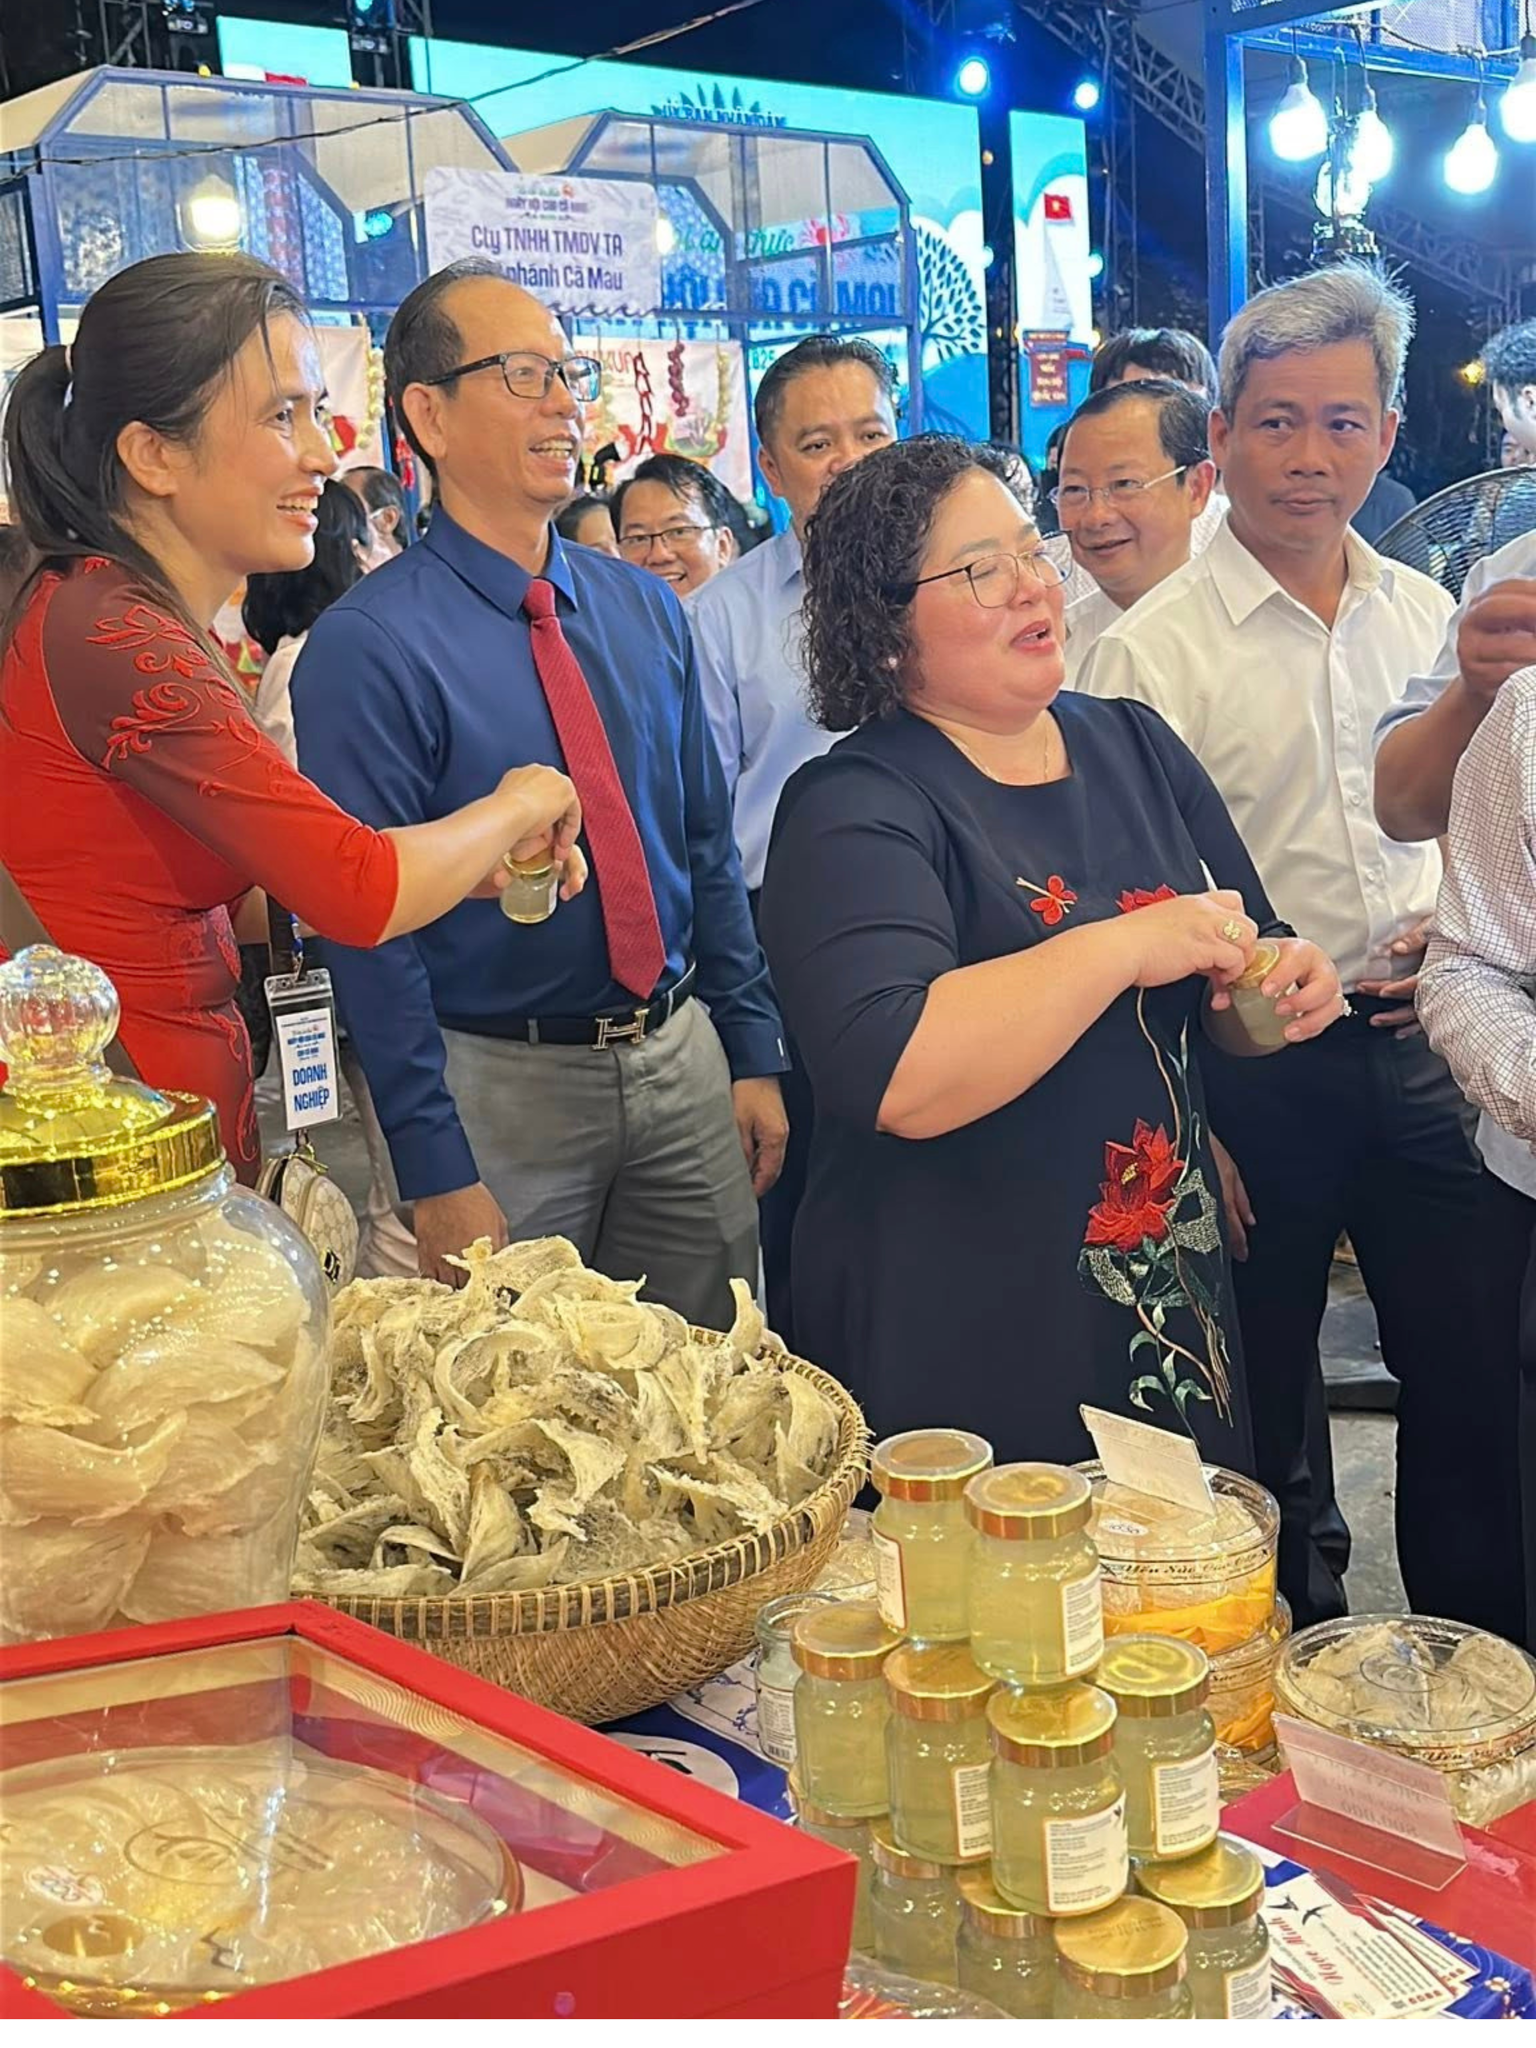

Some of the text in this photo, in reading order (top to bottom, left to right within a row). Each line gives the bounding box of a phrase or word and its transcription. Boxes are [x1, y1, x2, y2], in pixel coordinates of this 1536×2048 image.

[471, 225, 622, 257] Cty TNHH TMDV TA
[588, 266, 623, 290] Mau
[292, 1063, 328, 1087] DOANH
[294, 1086, 330, 1112] NGHIỆP
